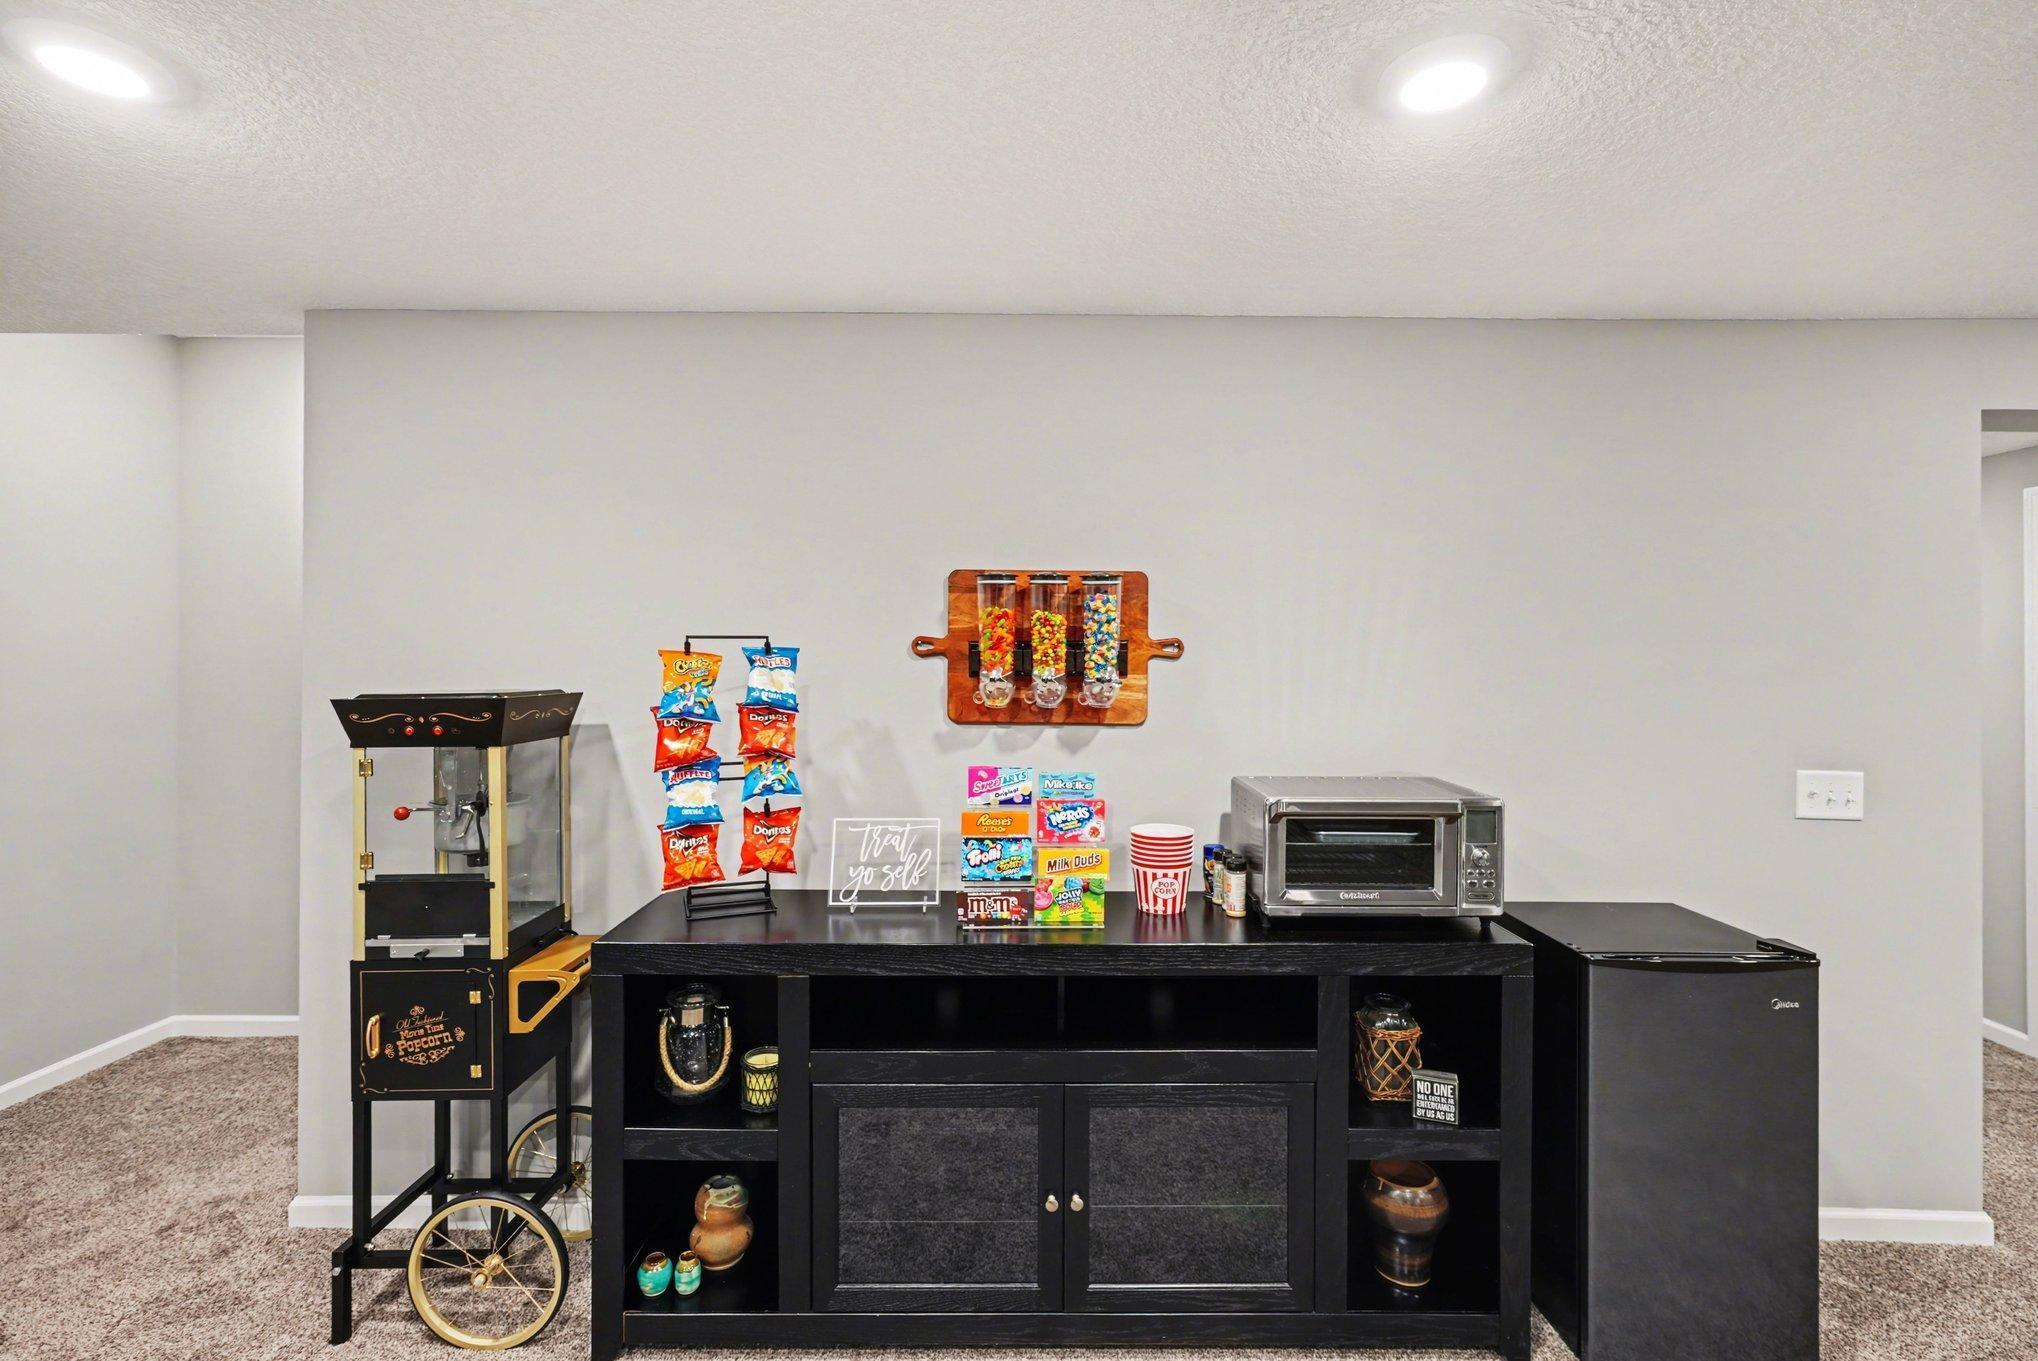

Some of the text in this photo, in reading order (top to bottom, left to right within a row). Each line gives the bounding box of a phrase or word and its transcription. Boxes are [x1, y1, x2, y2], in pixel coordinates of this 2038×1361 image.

[753, 825, 792, 837] Doritos
[669, 834, 709, 851] Doritos
[1046, 853, 1102, 872] Milk Duds
[839, 865, 877, 902] yo
[396, 1032, 453, 1056] Popcorn
[1416, 1080, 1454, 1098] NO ONE
[1416, 1108, 1426, 1117] BY
[1445, 1112, 1455, 1122] US
